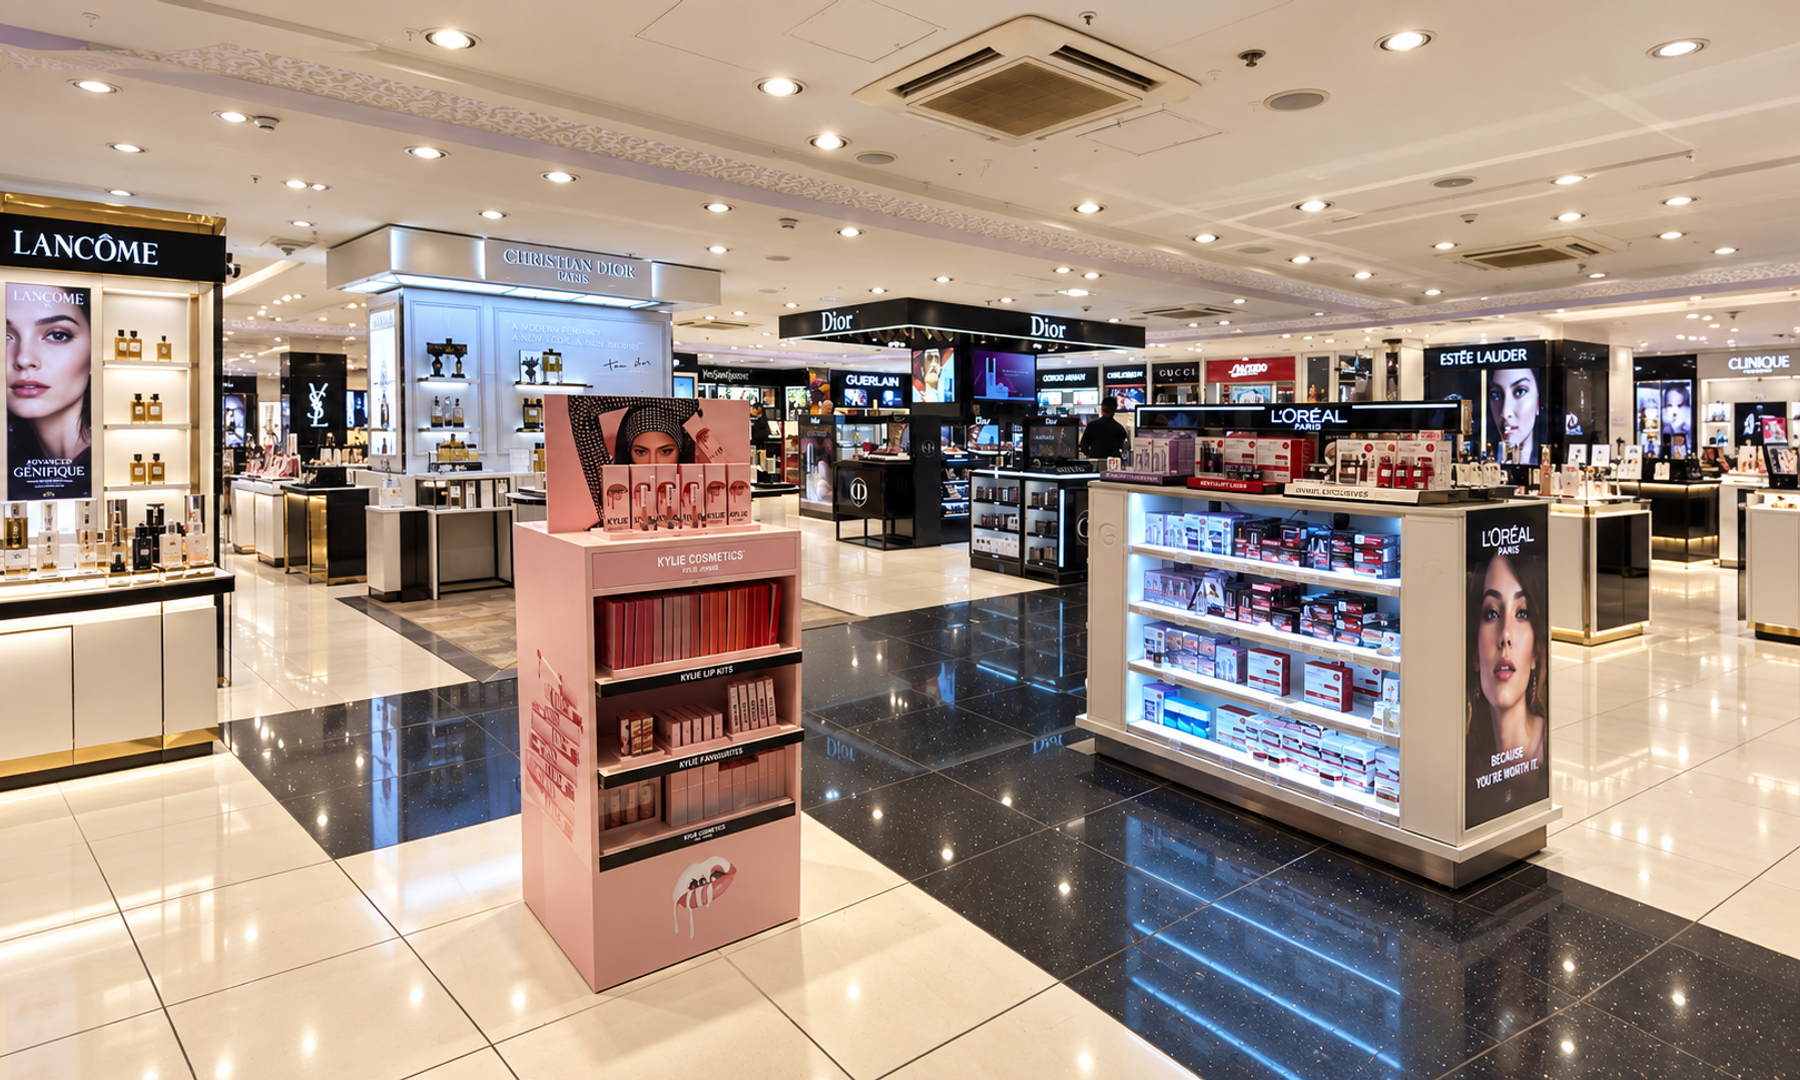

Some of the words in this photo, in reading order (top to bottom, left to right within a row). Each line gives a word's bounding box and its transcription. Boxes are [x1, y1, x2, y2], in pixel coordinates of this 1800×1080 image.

[13, 229, 159, 266] LANCÔME
[503, 248, 592, 272] CHRISTIAN
[597, 260, 636, 279] DIOR
[557, 270, 590, 284] PARIS
[821, 311, 853, 332] Dior
[1030, 316, 1067, 339] Dior
[1477, 348, 1528, 364] LAUDER
[1727, 354, 1790, 371] CLINIQUE
[845, 373, 900, 388] GUERLAIN
[1158, 368, 1196, 378] GUCCI
[1271, 407, 1348, 424] L'ORÉAL
[607, 516, 629, 526] KYLIE
[1482, 524, 1535, 548] L'ORÉAL
[1497, 544, 1520, 556] PARIS
[657, 554, 686, 568] KYLIE
[689, 550, 744, 565] COSMETICS
[680, 671, 702, 682] KYLIE
[716, 665, 734, 676] KITS
[679, 756, 699, 769] KYLIE
[1491, 746, 1524, 767] BECAUSE
[1475, 769, 1503, 790] YOU'RE
[1503, 760, 1530, 780] WORTH
